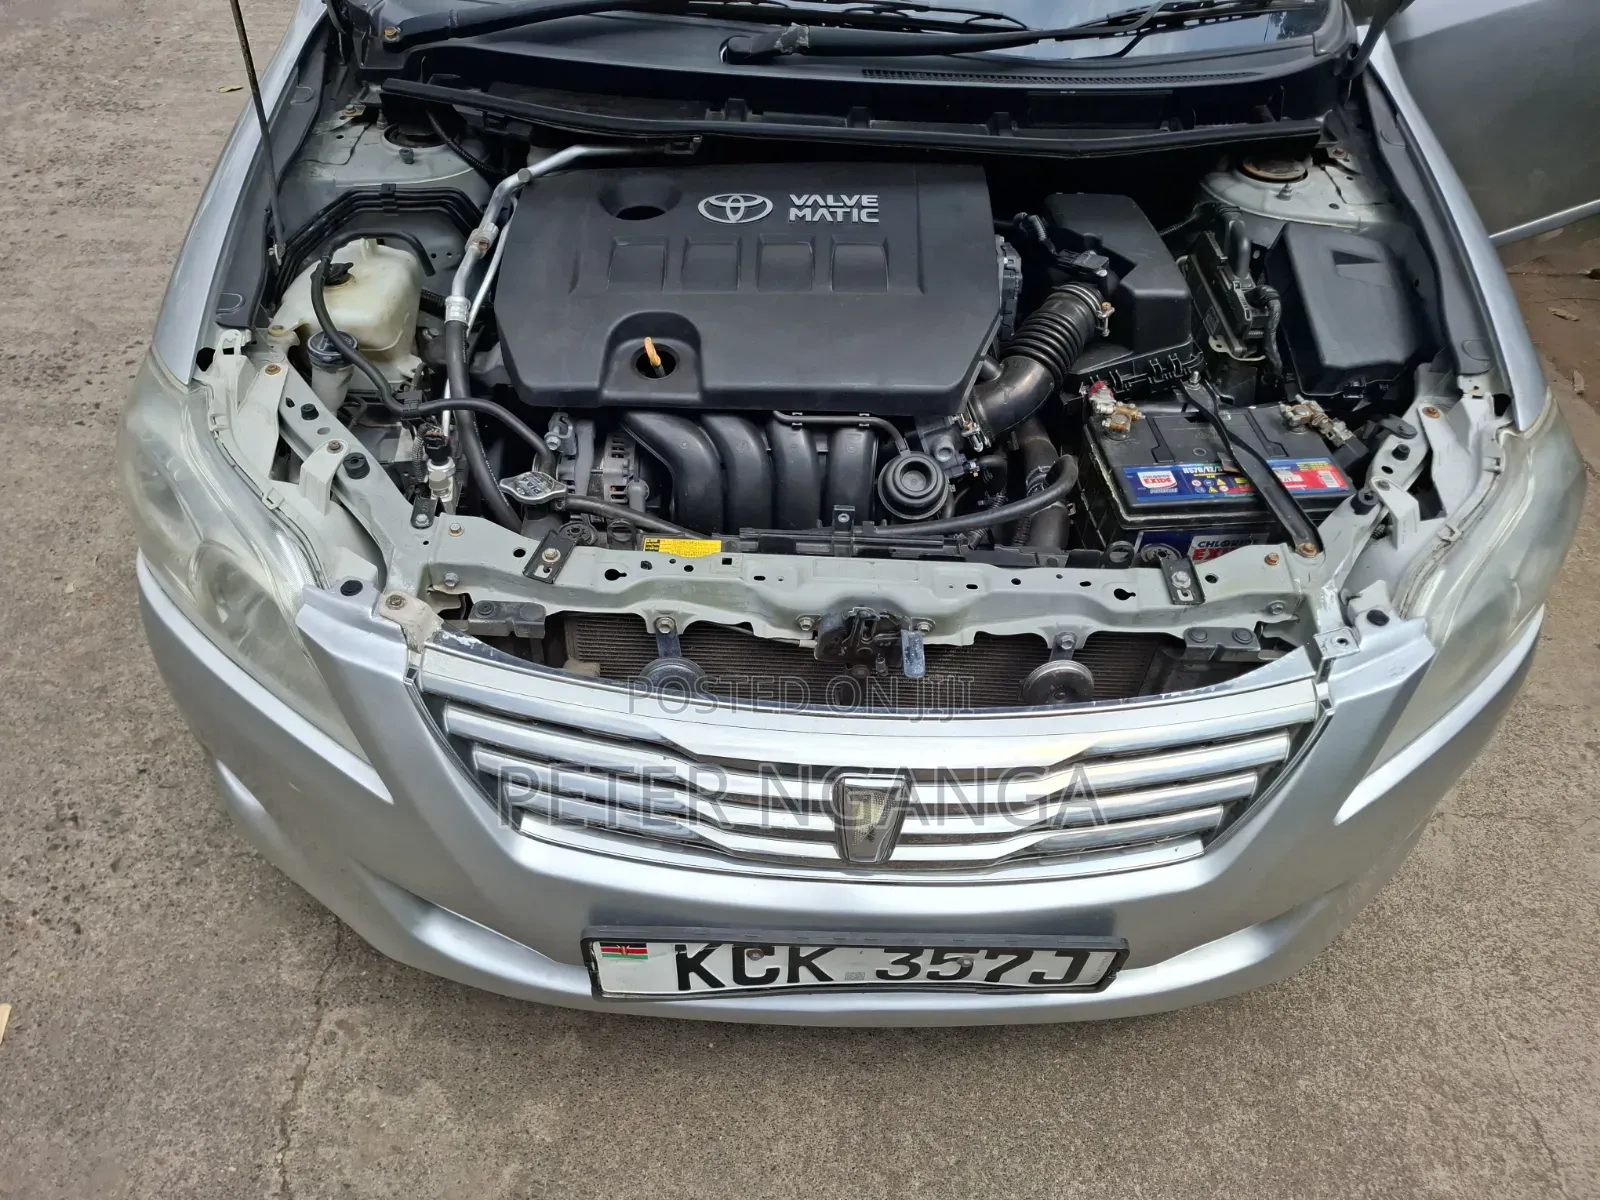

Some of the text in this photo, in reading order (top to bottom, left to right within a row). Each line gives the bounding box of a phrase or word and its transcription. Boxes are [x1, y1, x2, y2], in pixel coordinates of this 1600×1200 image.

[789, 194, 879, 206] VALVE
[789, 207, 879, 222] MATIC
[1144, 477, 1173, 485] EXIDE
[674, 943, 834, 990] KCK
[876, 948, 1091, 986] 357J
